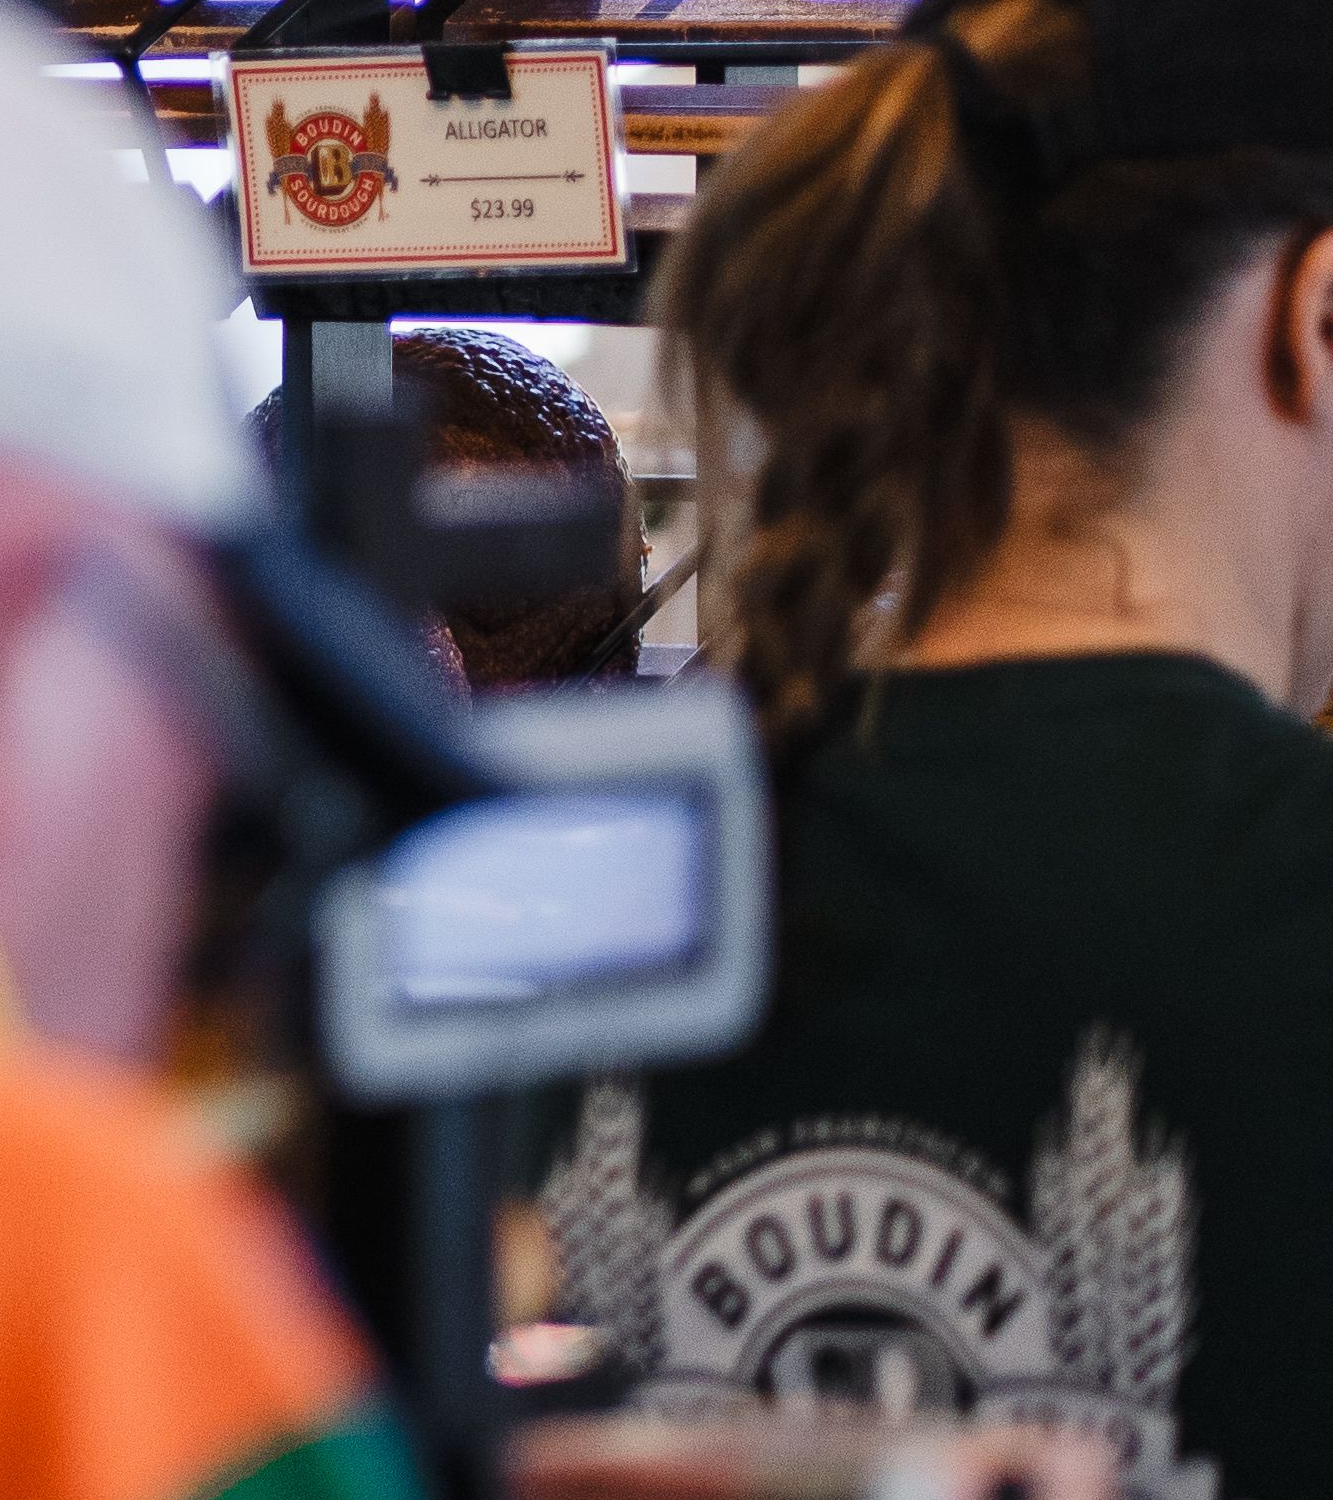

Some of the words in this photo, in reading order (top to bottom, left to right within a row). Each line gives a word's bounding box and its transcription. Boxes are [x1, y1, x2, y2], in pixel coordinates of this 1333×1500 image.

[295, 119, 363, 147] BOUDIN
[445, 118, 548, 141] ALLIGATOR
[310, 144, 354, 197] B
[290, 178, 374, 220] SOURDOUGH
[470, 197, 535, 222] $23.99
[690, 1191, 1025, 1340] BOUDIN
